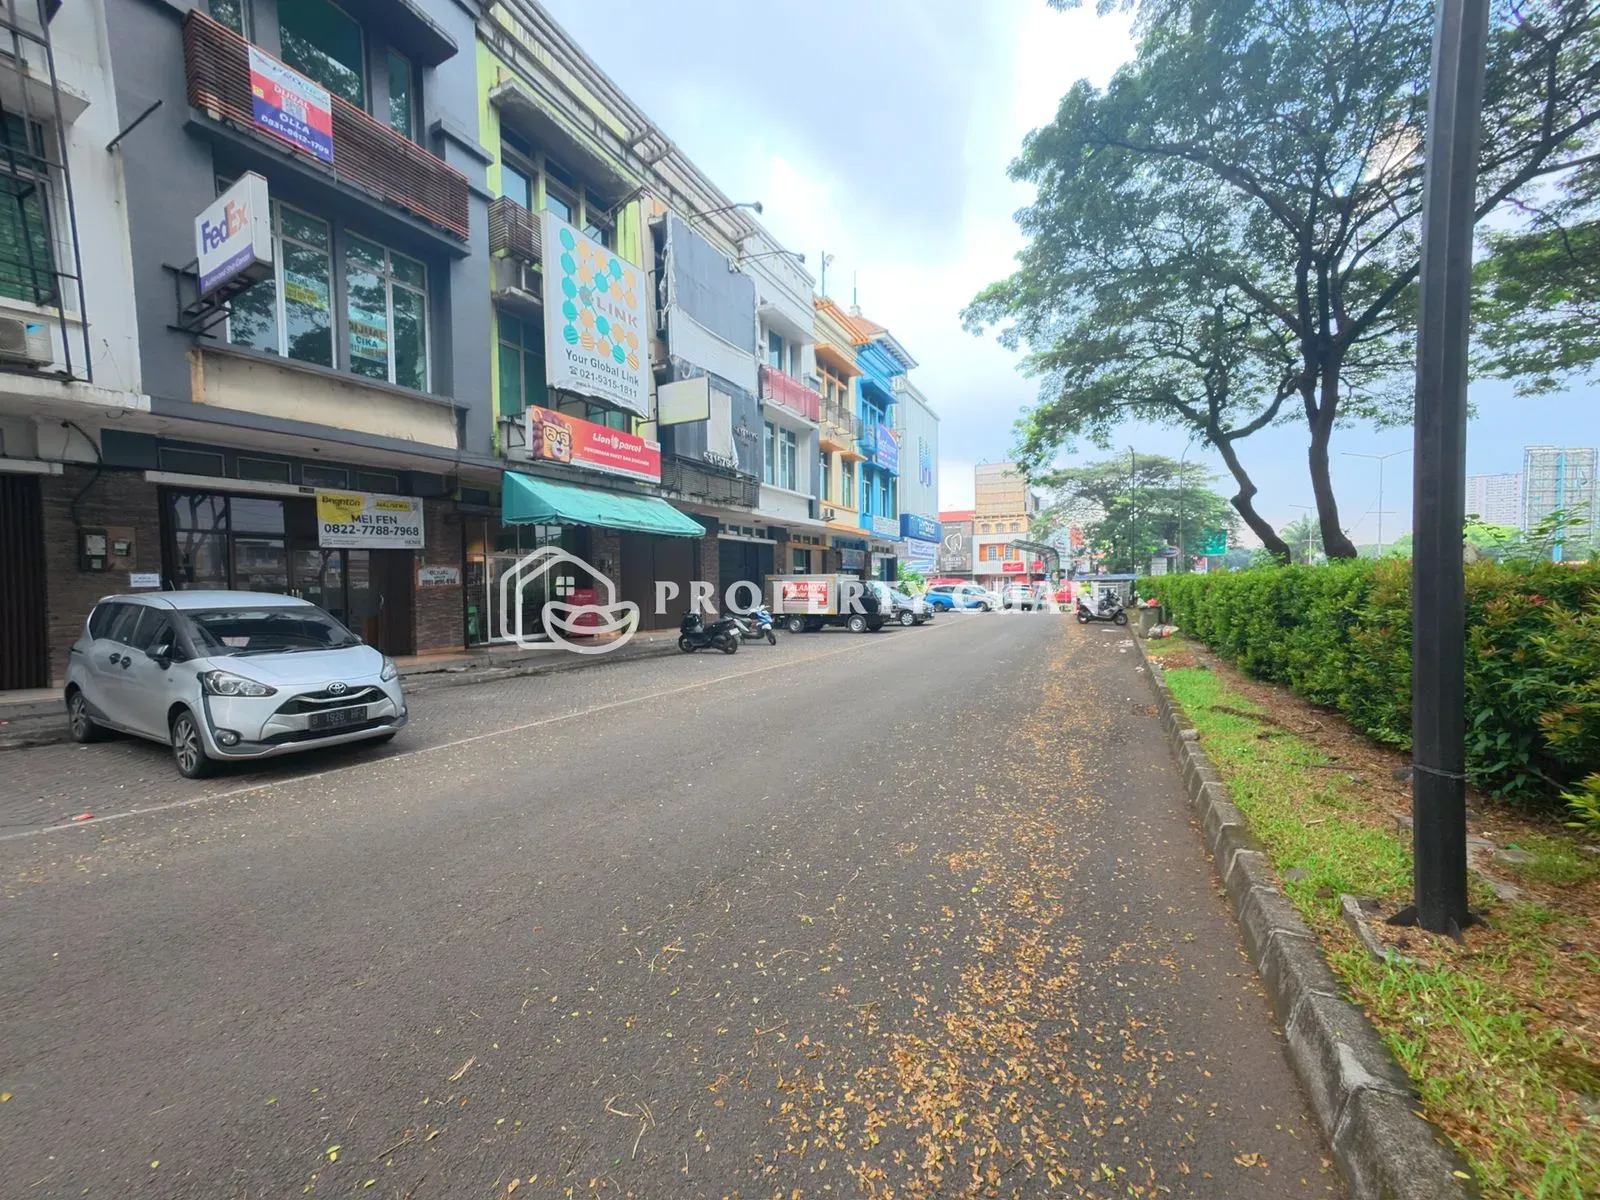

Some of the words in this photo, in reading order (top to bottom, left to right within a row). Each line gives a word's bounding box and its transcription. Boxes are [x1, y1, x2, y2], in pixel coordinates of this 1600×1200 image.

[273, 83, 310, 111] DIJUAL
[279, 111, 310, 135] OLLA
[201, 199, 249, 255] FedEx
[355, 335, 378, 348] CIKA
[565, 348, 588, 366] Your
[590, 357, 619, 376] Global
[621, 365, 639, 387] Link
[592, 432, 611, 446] Lion
[618, 441, 642, 453] parcel
[324, 523, 419, 537] 0822-7788-7968
[351, 514, 372, 525] MEI
[376, 514, 398, 525] FEN
